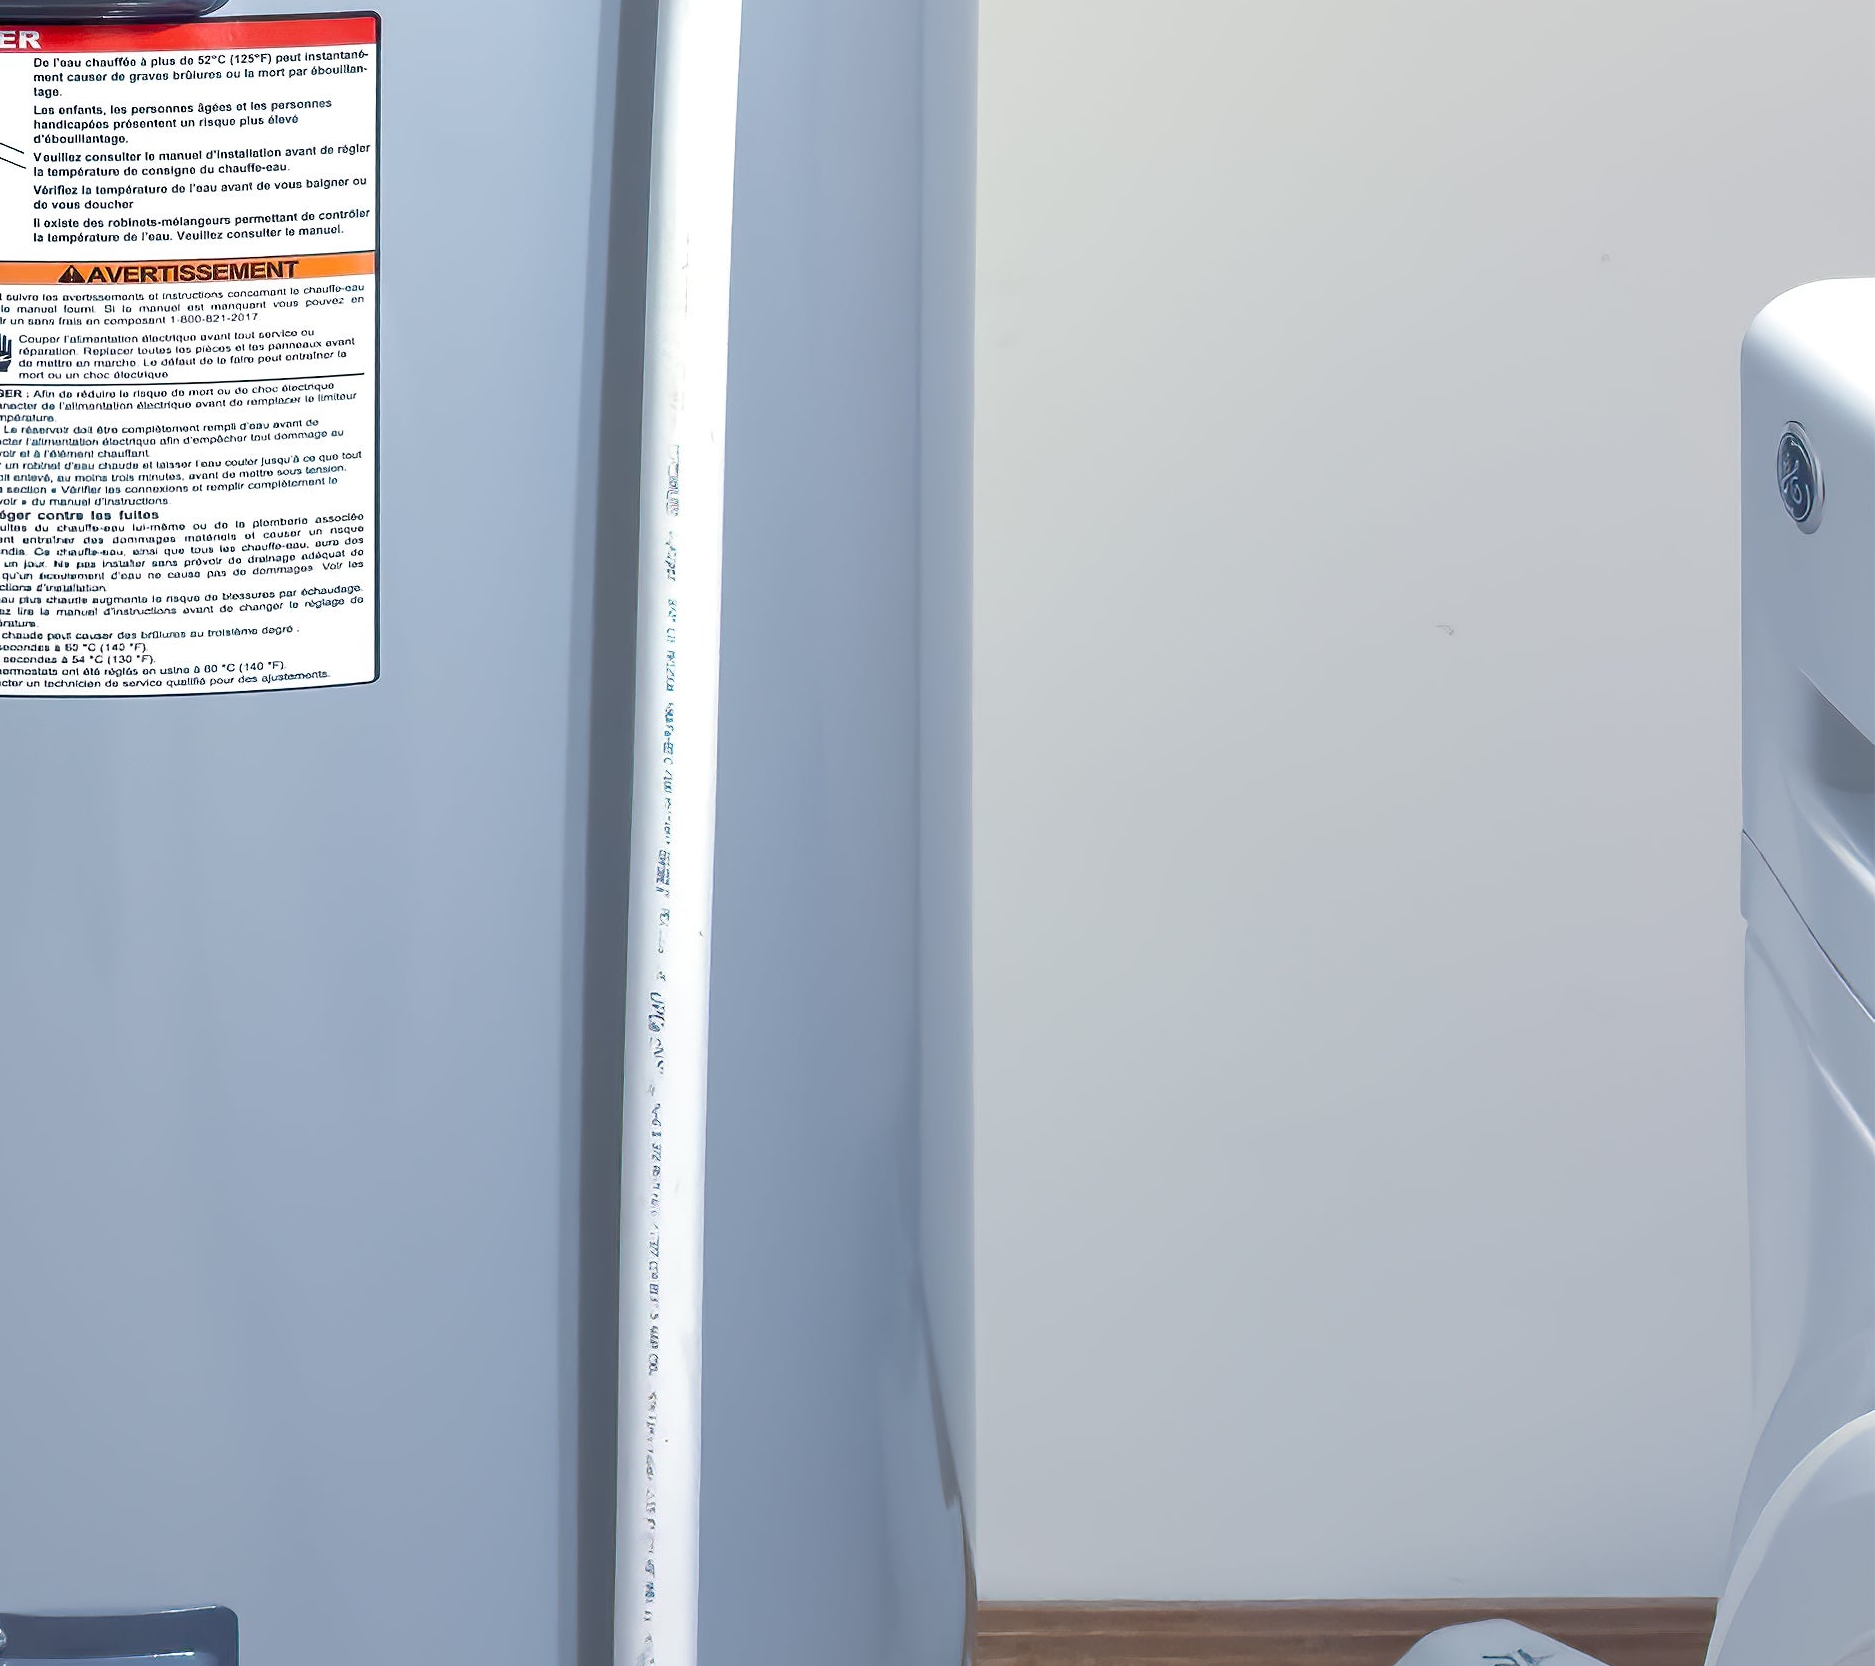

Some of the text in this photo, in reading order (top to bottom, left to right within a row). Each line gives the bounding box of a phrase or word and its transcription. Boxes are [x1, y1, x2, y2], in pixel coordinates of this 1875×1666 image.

[33, 48, 368, 68] De l'eau chauffée à plus de 52°C (125°F) peut instantané-
[87, 260, 299, 284] AVERTISSEMENT
[37, 508, 83, 520] contre
[91, 508, 111, 520] les
[119, 508, 159, 520] fuites
